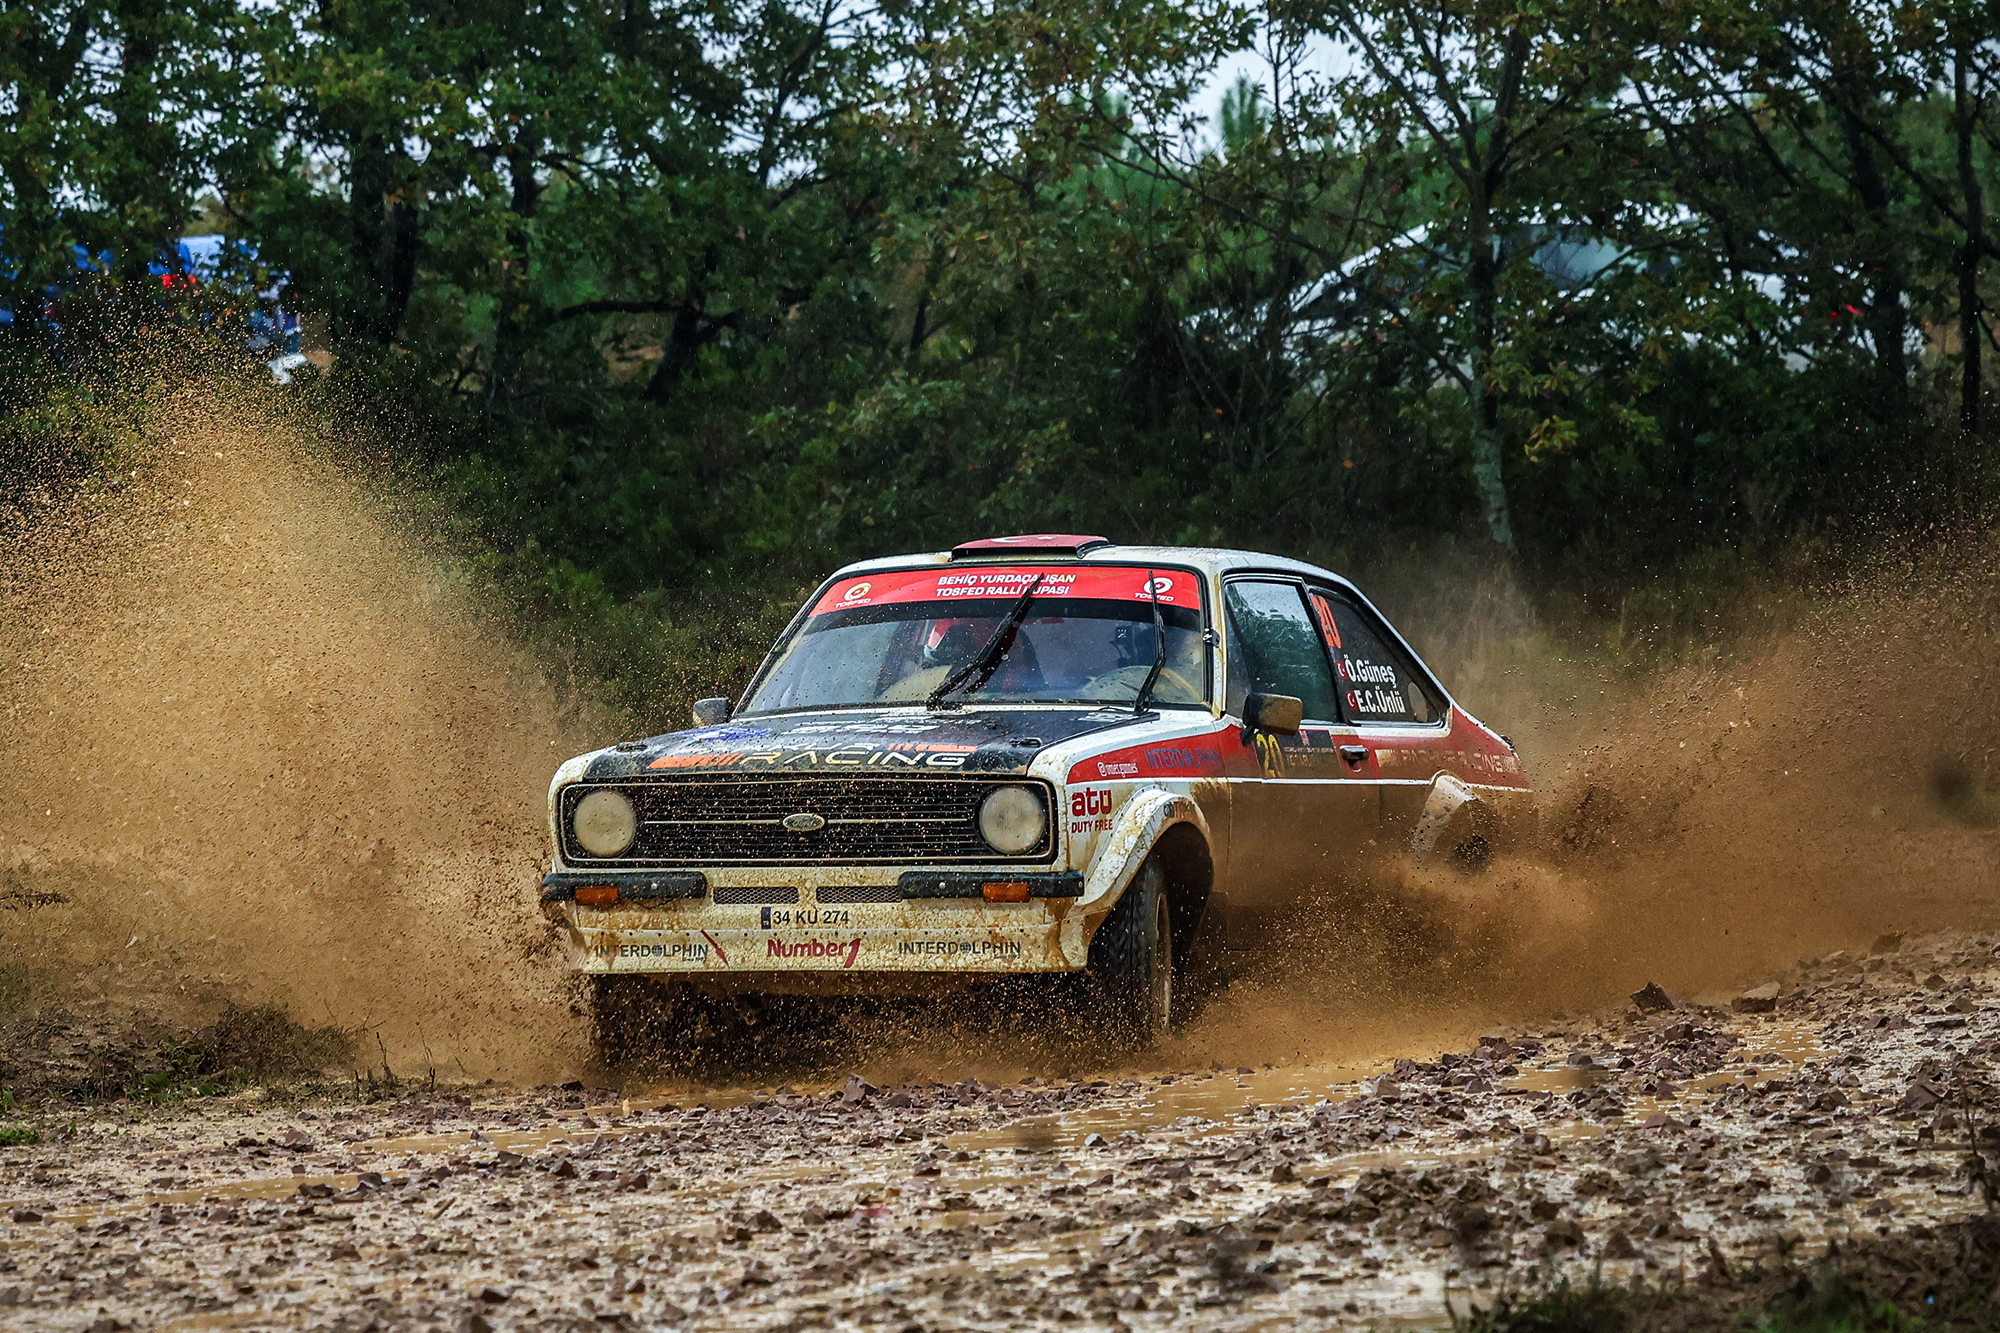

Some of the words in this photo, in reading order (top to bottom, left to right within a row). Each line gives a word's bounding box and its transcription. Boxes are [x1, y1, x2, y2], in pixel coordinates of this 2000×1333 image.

[937, 574, 977, 585] BEHİÇ
[936, 586, 985, 597] TOSFED
[985, 584, 1022, 595] RALLİ
[835, 598, 872, 608] TOSFED
[1344, 654, 1397, 689] Ö.Güneş
[1354, 686, 1406, 713] E.C.Ünlü
[739, 750, 970, 767] RACING
[1072, 820, 1093, 833] DUTY
[1095, 819, 1113, 831] FREE
[773, 910, 791, 925] 34
[796, 910, 818, 925] KU
[823, 910, 849, 925] 274
[898, 941, 1020, 955] INTERDOLPHIN
